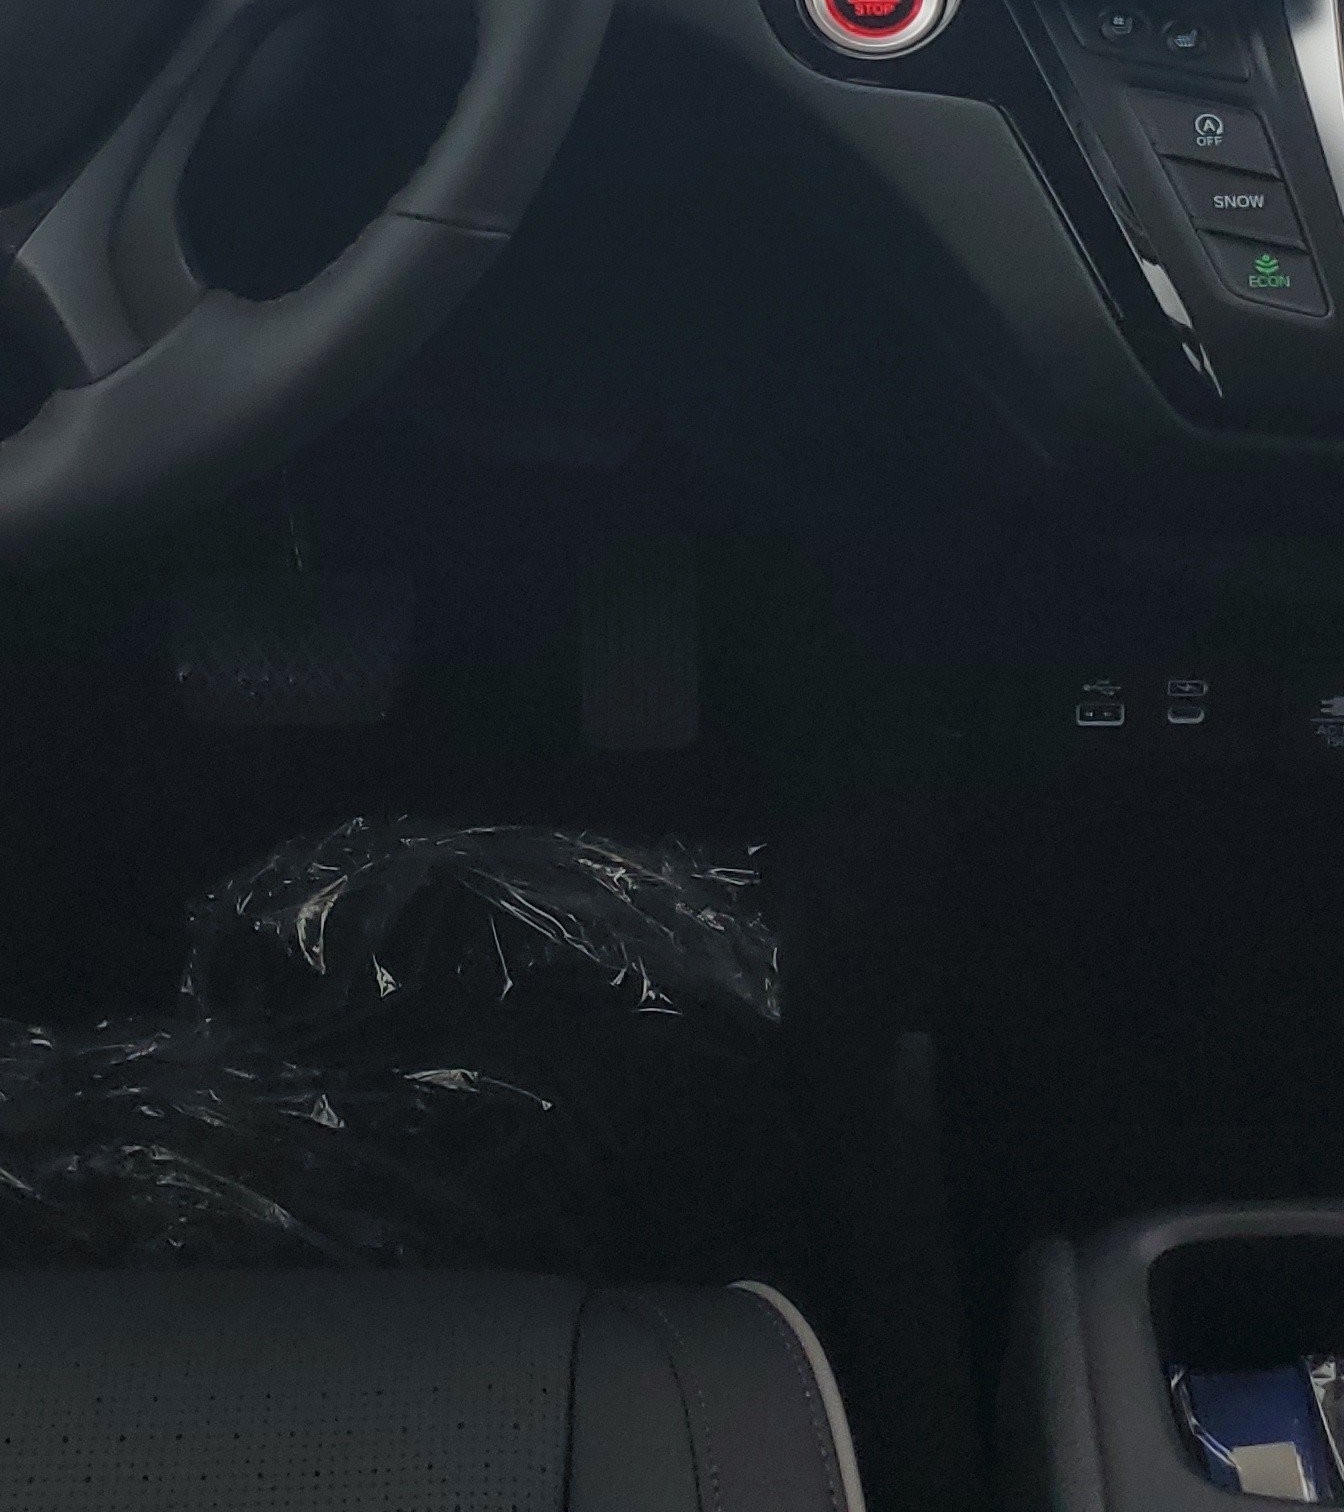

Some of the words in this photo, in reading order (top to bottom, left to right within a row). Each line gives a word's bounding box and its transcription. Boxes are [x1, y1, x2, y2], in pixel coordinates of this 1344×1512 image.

[854, 3, 896, 16] STOP
[1196, 135, 1223, 147] OFF
[1213, 195, 1265, 209] SNOW
[1248, 275, 1291, 288] ECON
